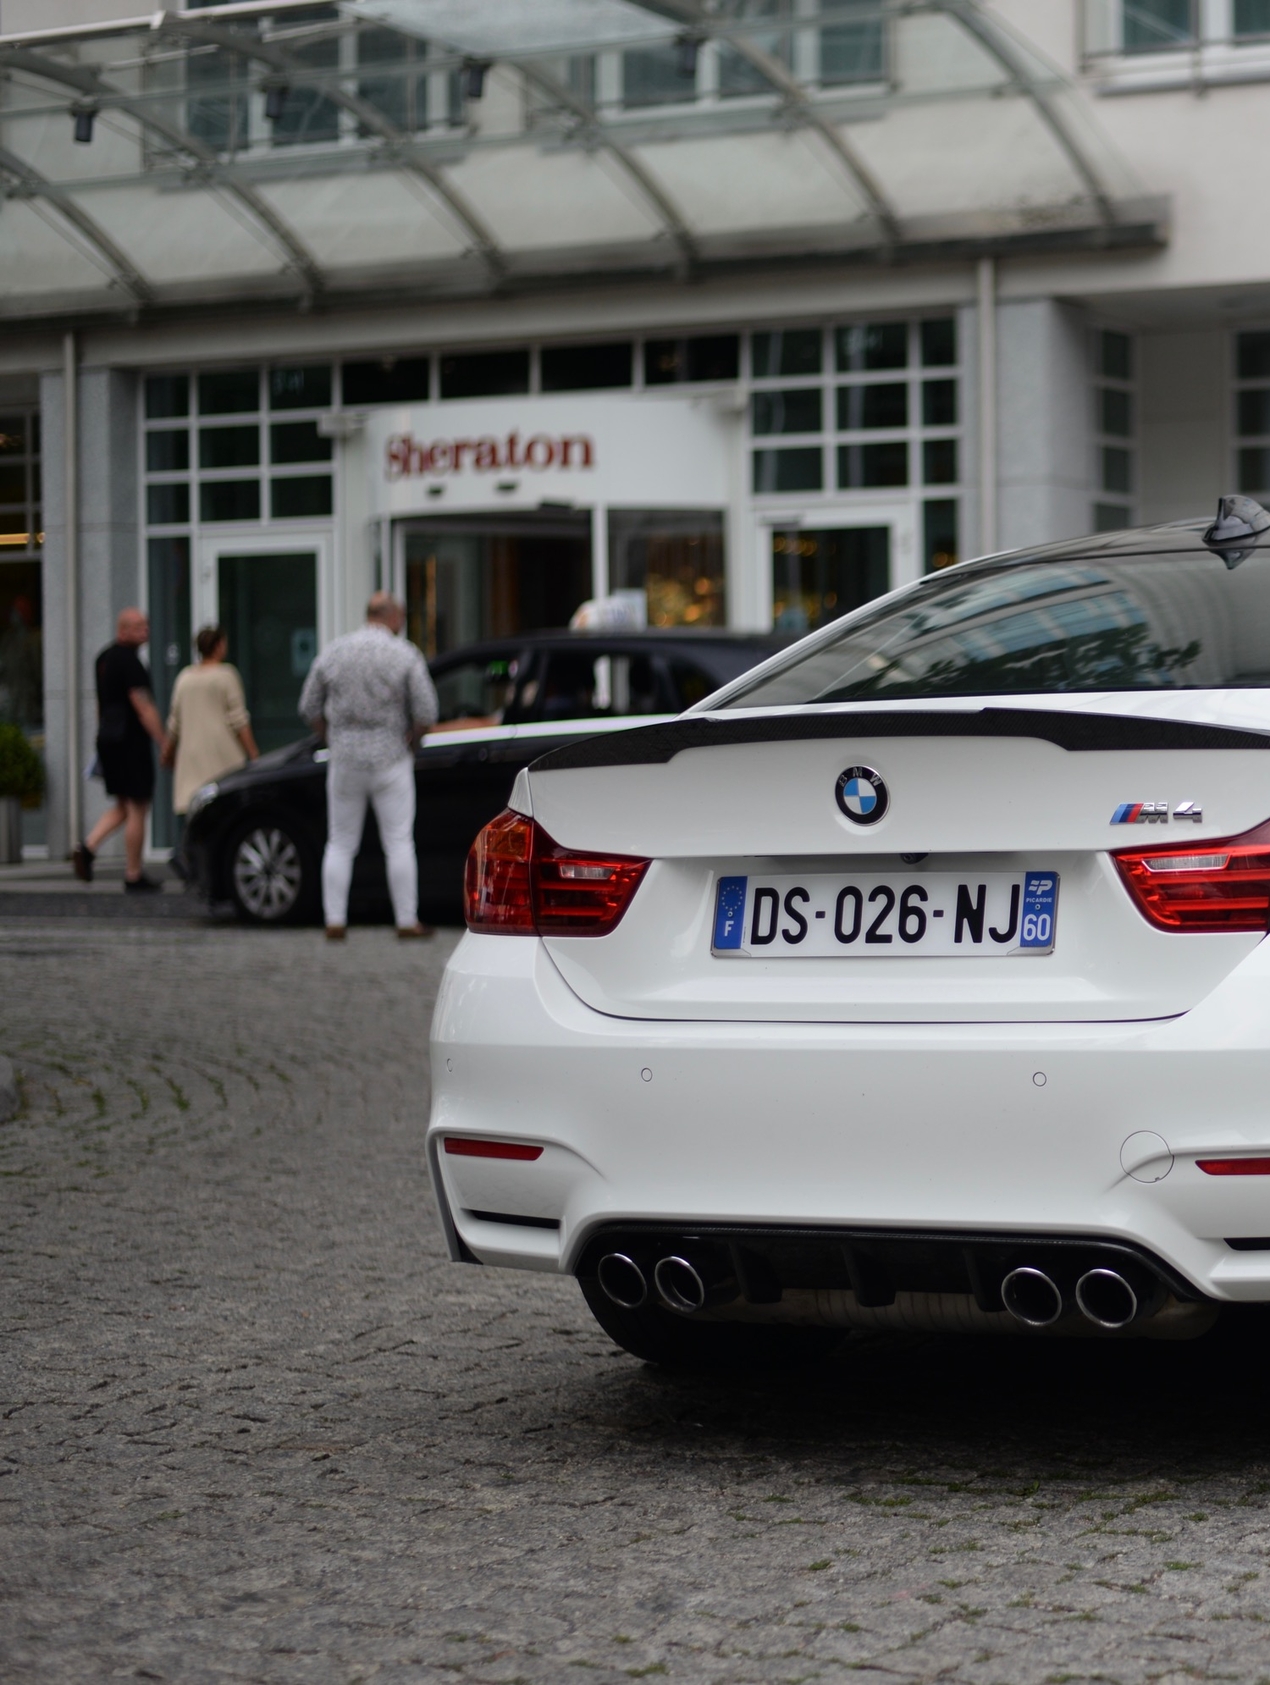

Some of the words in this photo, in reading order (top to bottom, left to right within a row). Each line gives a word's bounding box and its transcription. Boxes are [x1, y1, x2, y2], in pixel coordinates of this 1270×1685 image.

[386, 428, 595, 482] Sheraton
[839, 767, 883, 787] BMW
[751, 885, 1020, 944] DS-026-NJ
[1023, 914, 1051, 941] 60
[724, 921, 735, 937] F
